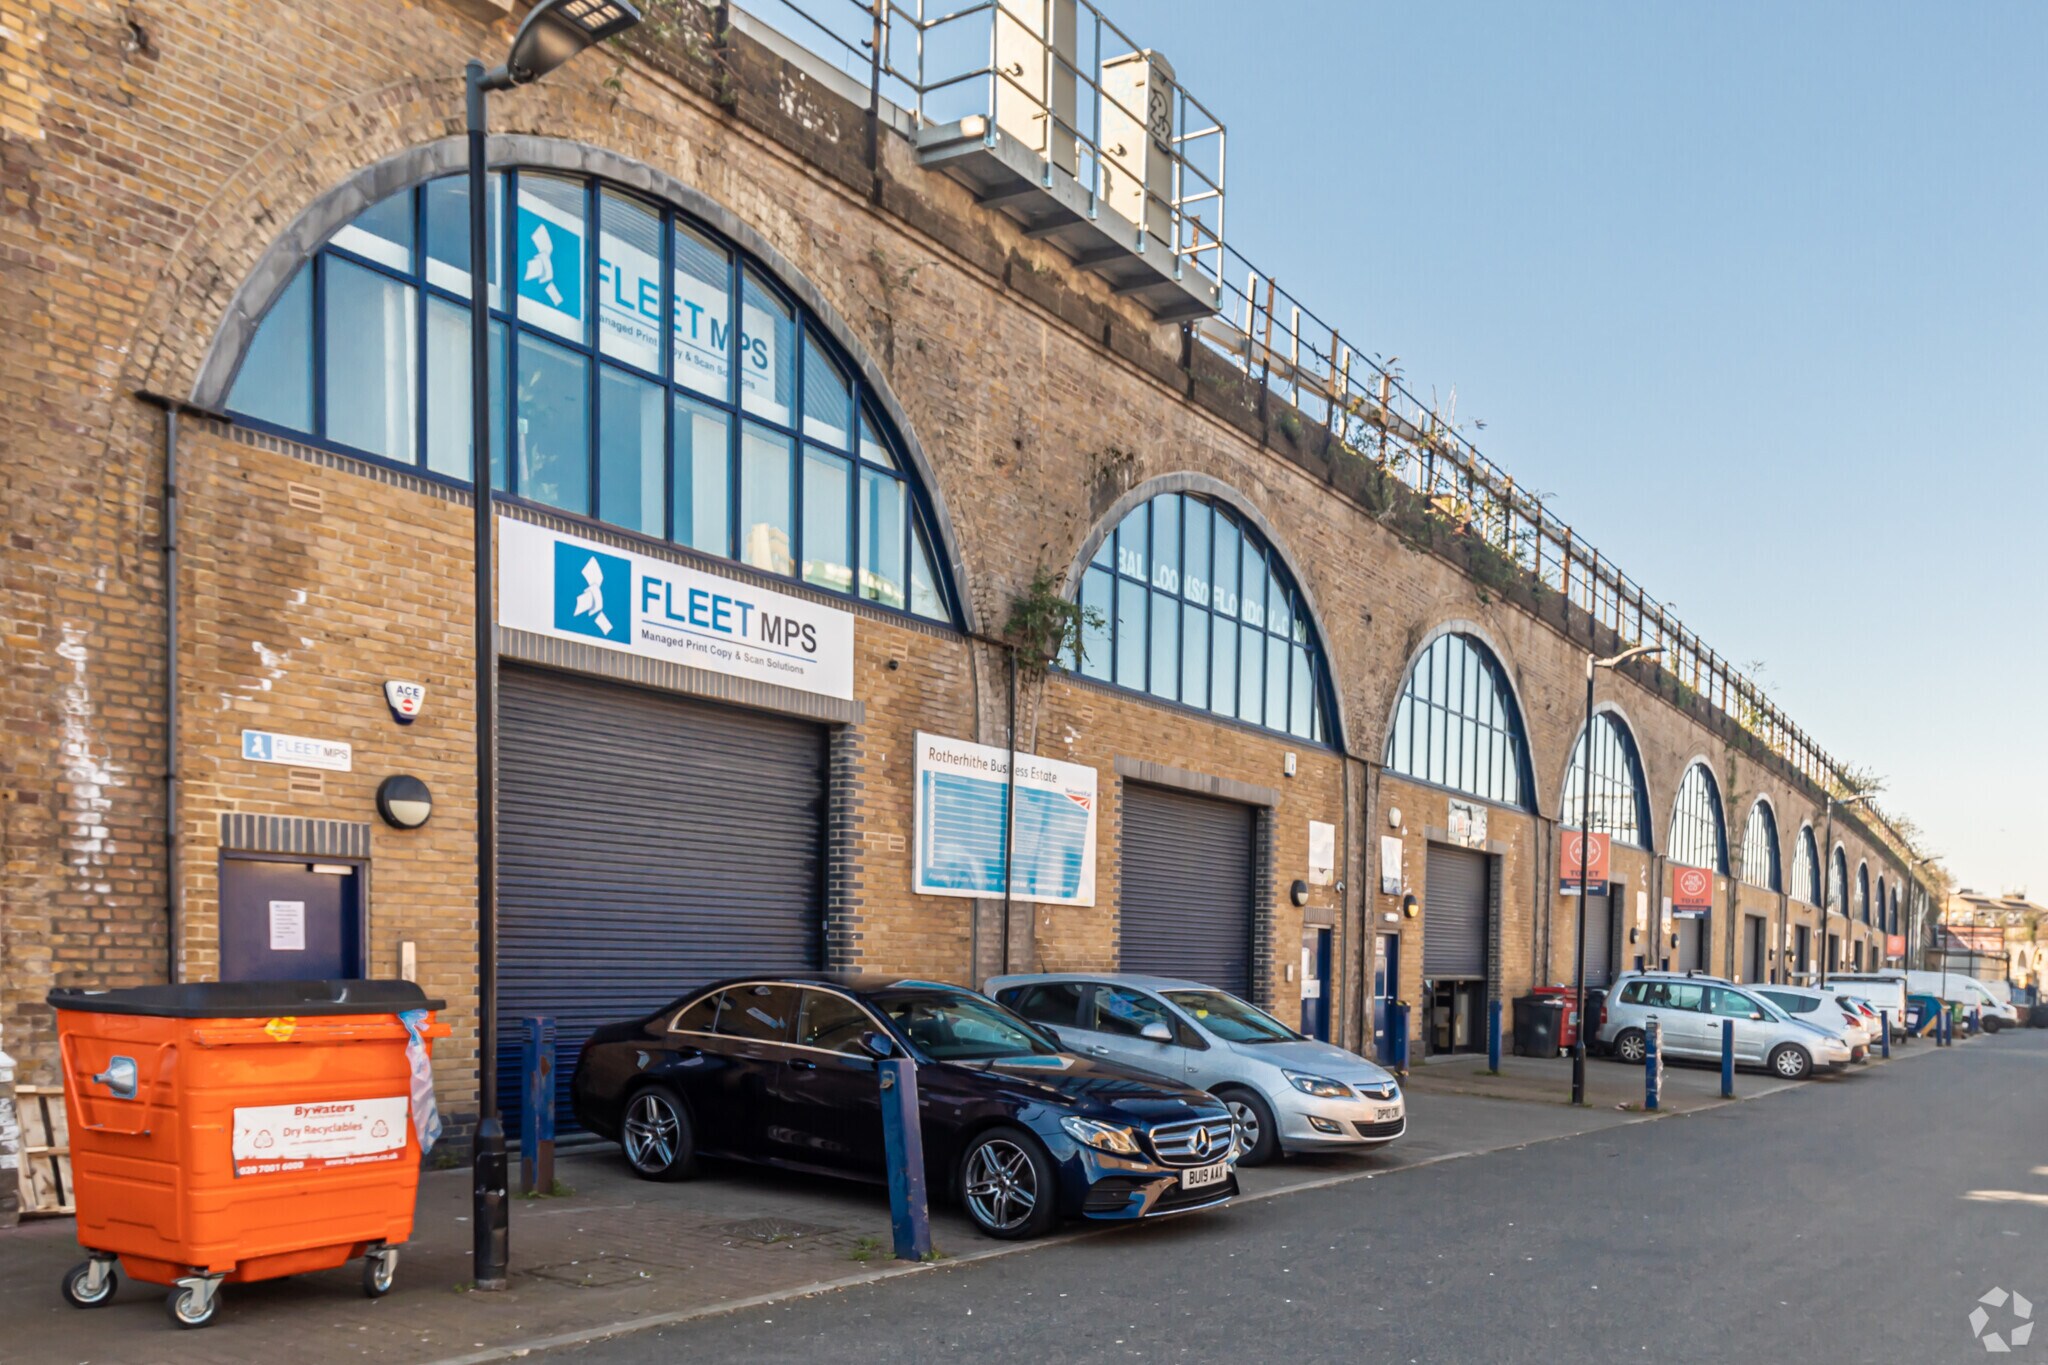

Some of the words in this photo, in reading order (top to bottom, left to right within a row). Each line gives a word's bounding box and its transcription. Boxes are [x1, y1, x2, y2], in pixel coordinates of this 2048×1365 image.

[600, 315, 634, 335] anaged
[636, 328, 658, 346] Print
[693, 355, 715, 371] Scan
[642, 574, 755, 637] FLEET
[761, 612, 817, 654] MPS
[641, 629, 684, 647] Managed
[686, 639, 708, 653] Print
[710, 645, 732, 660] Copy
[735, 650, 741, 660] &
[744, 652, 765, 665] Scan
[767, 658, 804, 675] Solutions
[396, 685, 420, 698] ACE
[276, 739, 321, 755] FLEET
[323, 747, 348, 760] MPS
[928, 746, 988, 770] Rotherhithe
[991, 759, 1029, 778] Busiess
[1030, 766, 1058, 783] Estate
[294, 1103, 355, 1118] Bywaters
[283, 1127, 301, 1138] Dry
[304, 1122, 363, 1136] Recyclables
[1189, 1168, 1209, 1185] BU19
